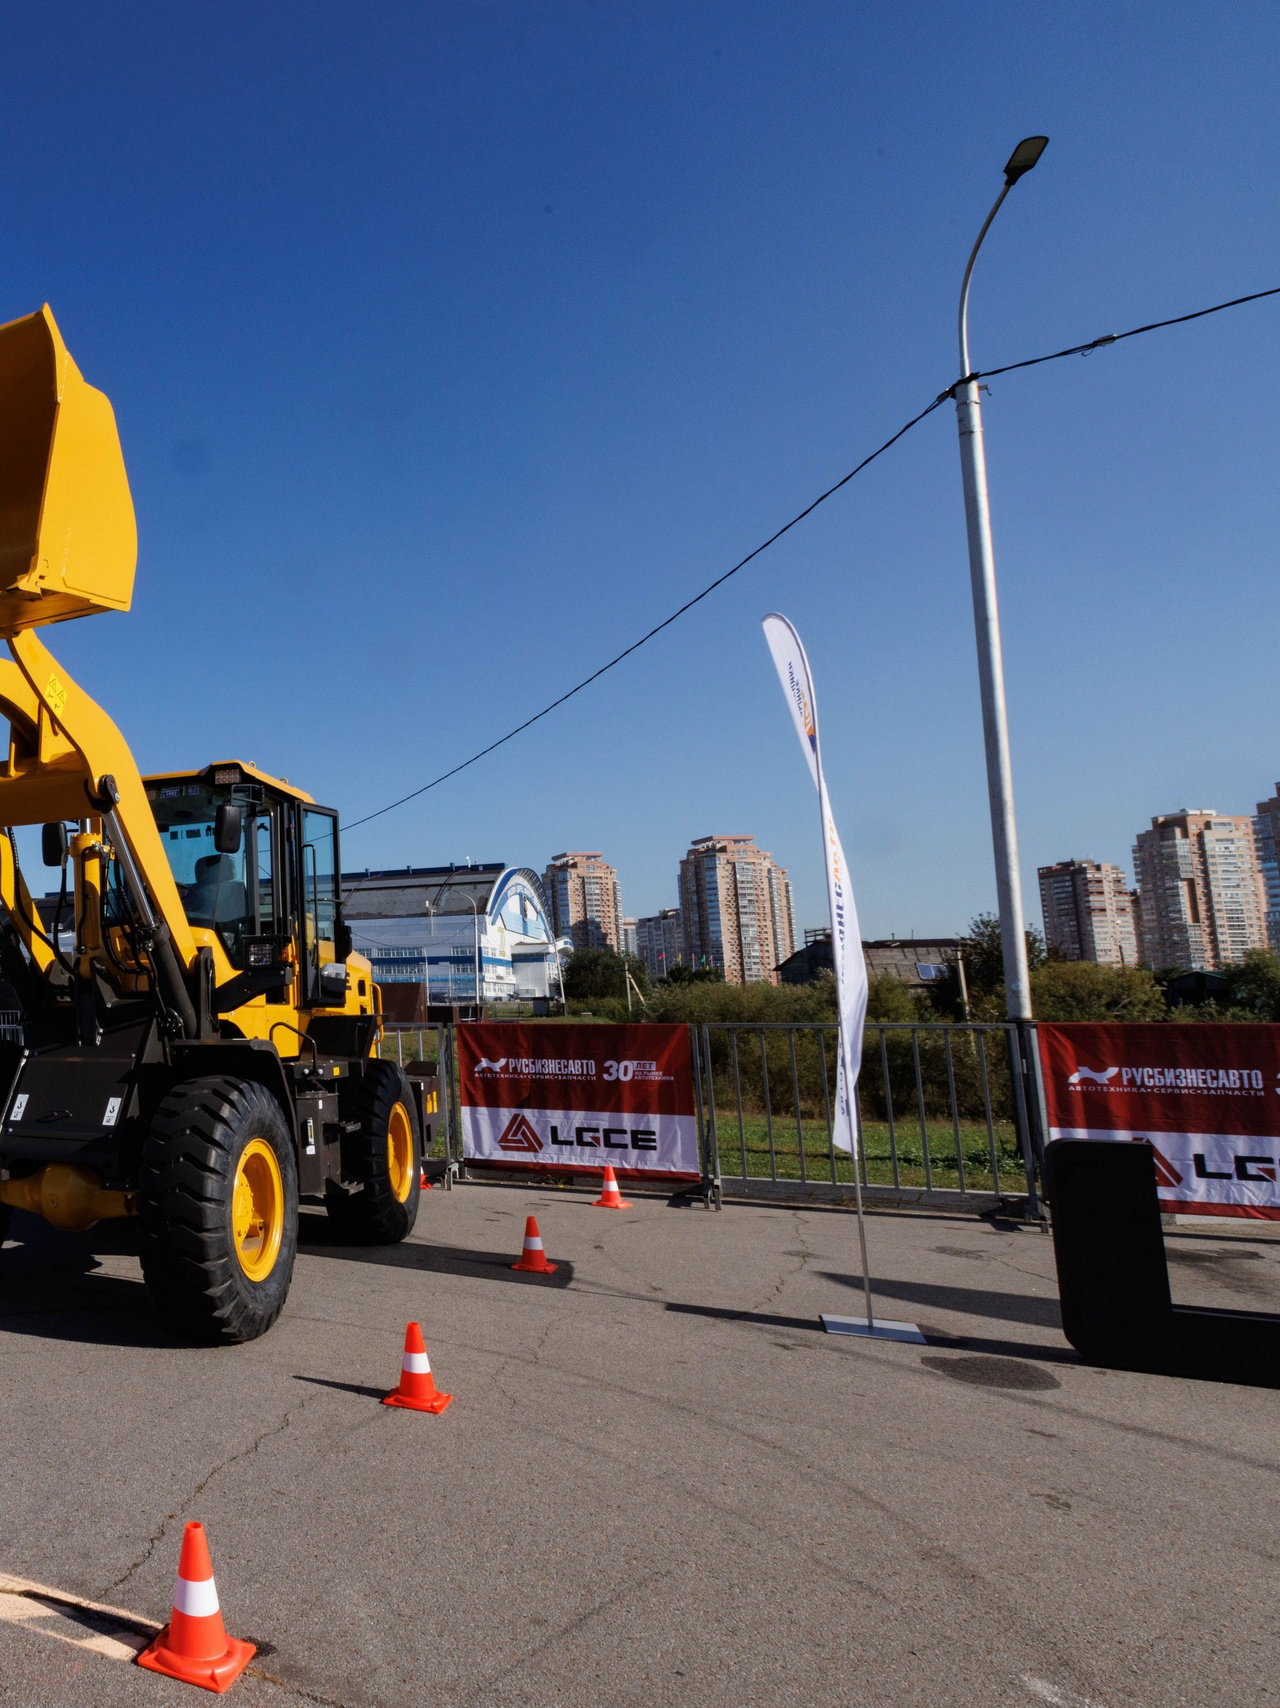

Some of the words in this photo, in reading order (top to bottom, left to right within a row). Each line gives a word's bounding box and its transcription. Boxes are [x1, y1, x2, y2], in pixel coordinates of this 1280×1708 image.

[509, 1058, 596, 1075] РУСБИЗНЕСАВТО
[603, 1060, 633, 1082] 30
[1122, 1067, 1264, 1089] РУСБИЗНЕСАВТО
[1068, 1085, 1146, 1093] АВТОТЕХНИКА
[1154, 1087, 1196, 1095] СЕРВИС
[1201, 1088, 1265, 1097] ЗАПЧАСТИ
[550, 1125, 657, 1150] LGCE
[1193, 1153, 1277, 1182] LG
